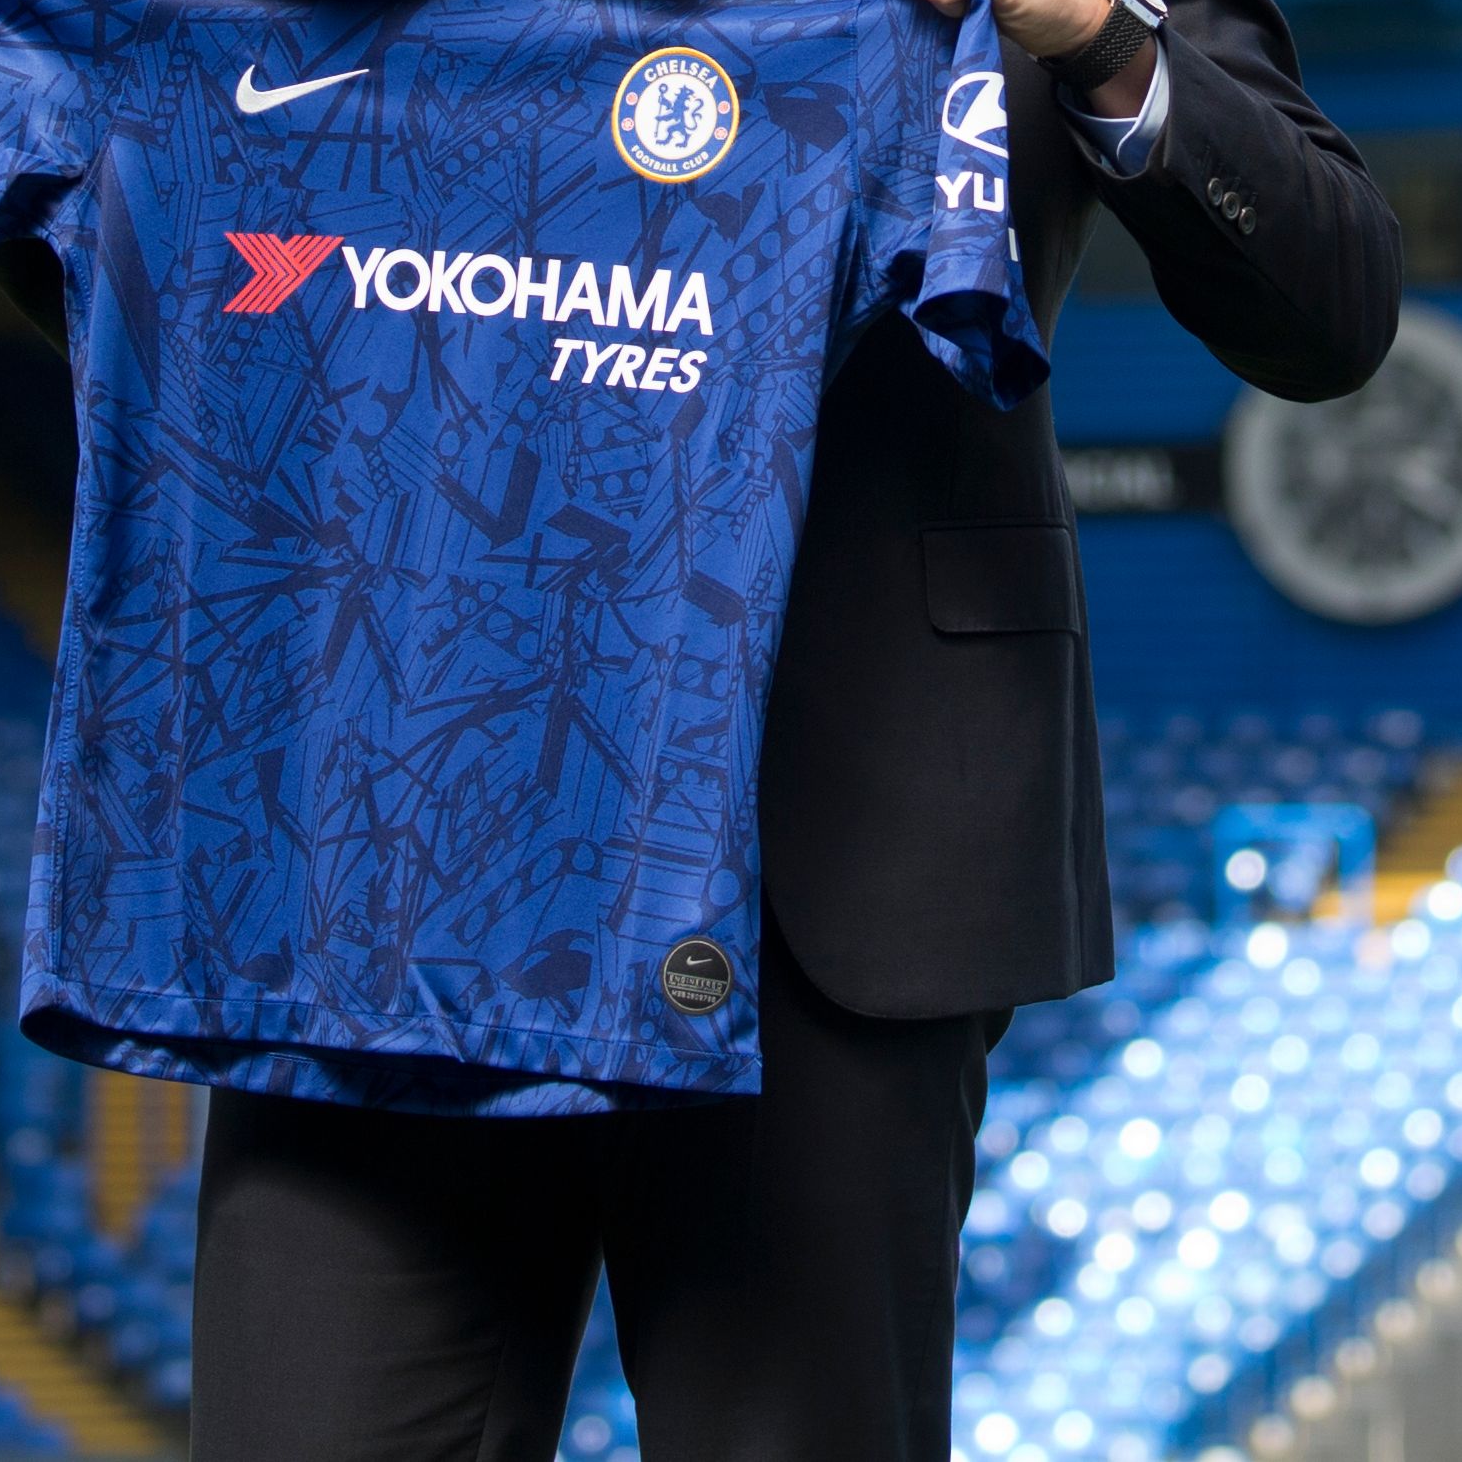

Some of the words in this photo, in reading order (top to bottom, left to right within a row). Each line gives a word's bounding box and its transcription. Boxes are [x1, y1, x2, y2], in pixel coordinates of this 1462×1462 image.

[643, 59, 719, 90] CHELSEA
[631, 144, 679, 173] FOOTBALL
[682, 150, 710, 170] CLUB
[341, 245, 715, 337] YOKOHAMA
[550, 338, 709, 395] TYRES
